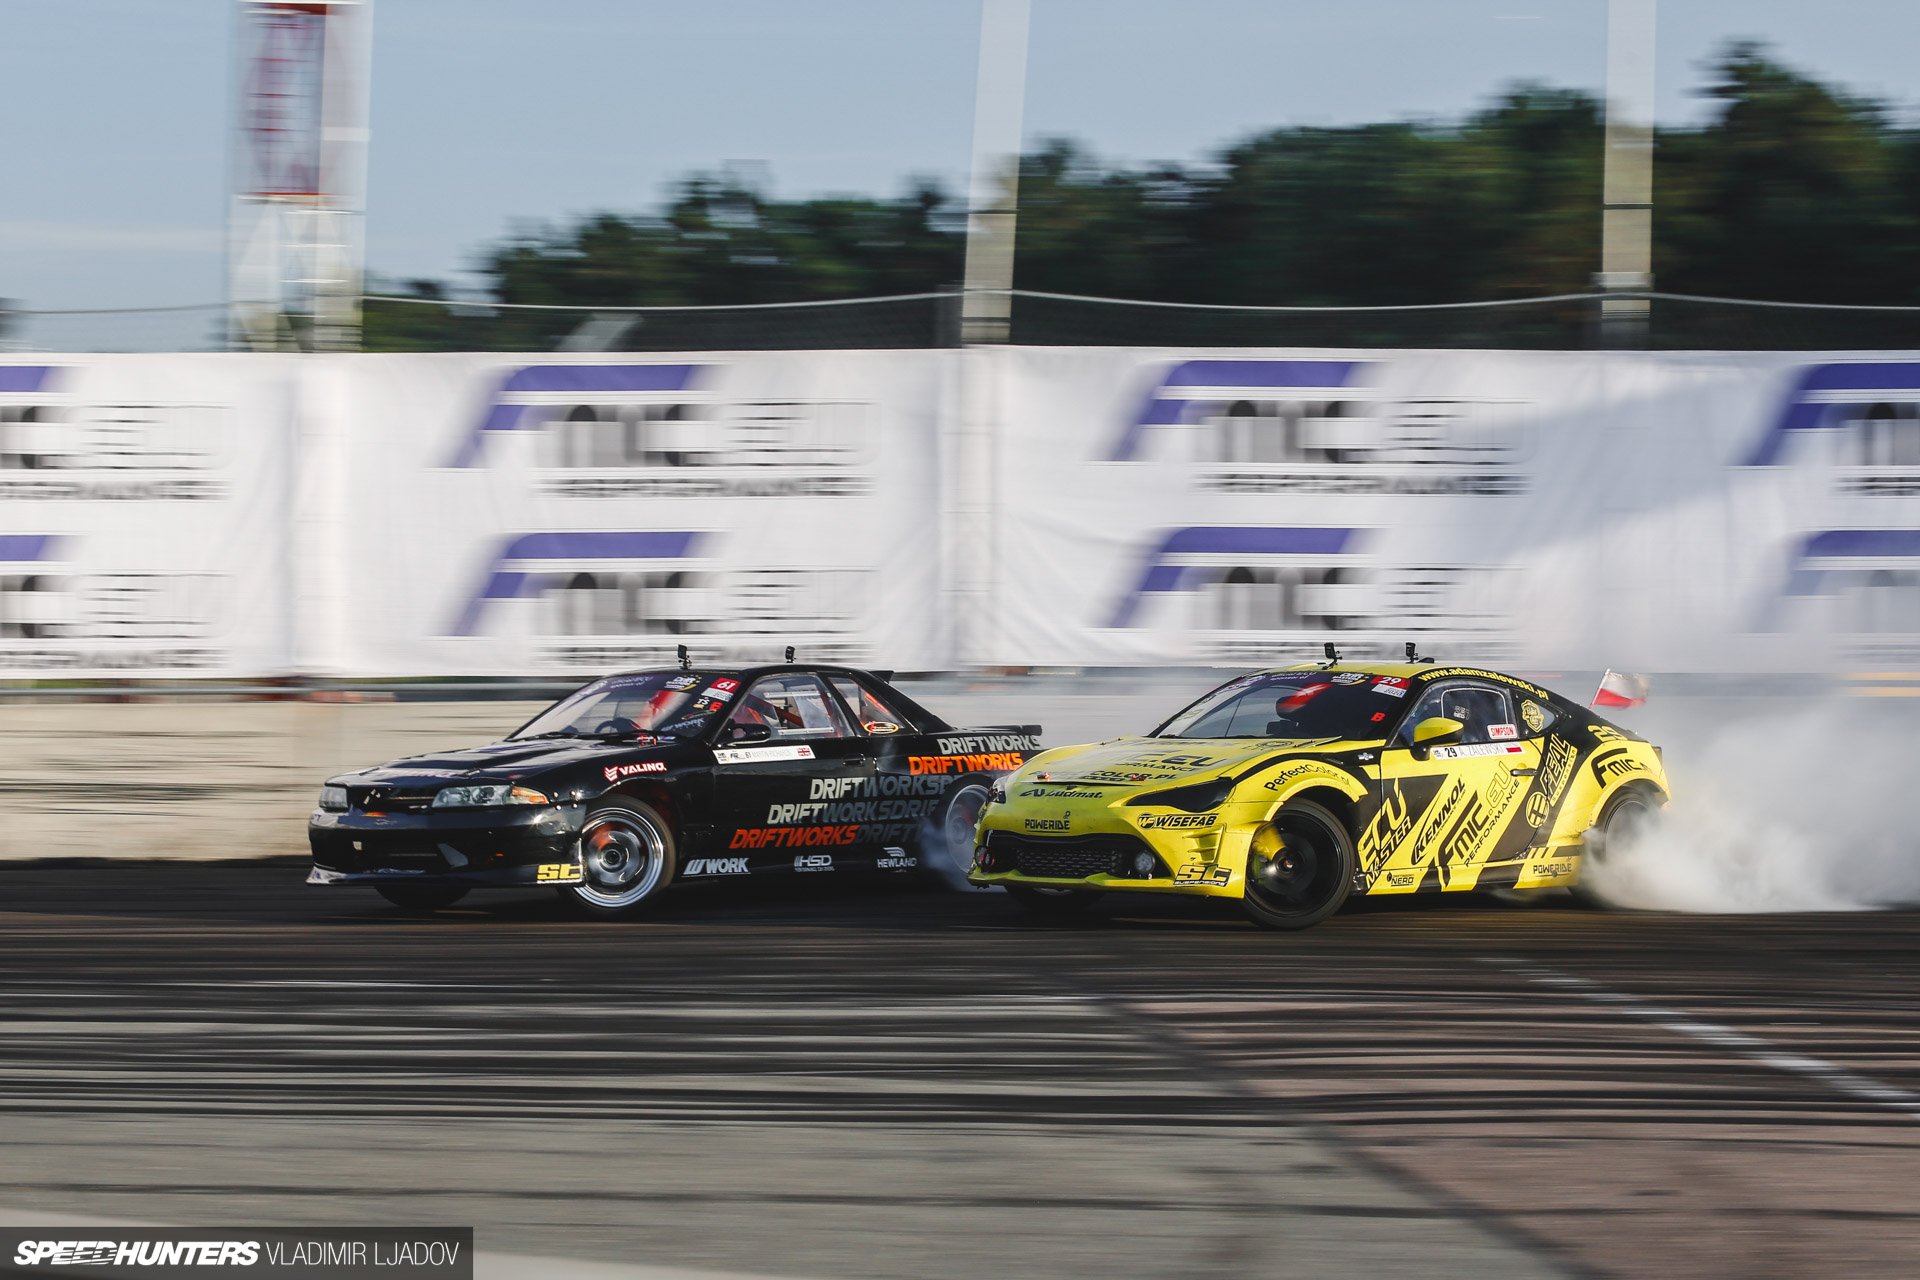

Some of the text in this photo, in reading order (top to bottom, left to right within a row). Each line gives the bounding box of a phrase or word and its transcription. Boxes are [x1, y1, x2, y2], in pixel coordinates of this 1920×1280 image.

[716, 681, 737, 690] 61
[1379, 676, 1402, 685] 29
[1418, 667, 1550, 701] www.adamzalewski.pl
[710, 701, 723, 711] B
[1371, 712, 1386, 722] B
[1490, 726, 1514, 737] SIMPSON
[1587, 725, 1629, 743] 29
[937, 735, 1043, 755] DRIFTWORKS
[1446, 747, 1458, 758] 29
[908, 752, 1024, 775] DRIFTWORKS
[1024, 818, 1071, 831] POWERIDE
[1155, 814, 1218, 828] WISEFAB
[1413, 777, 1465, 863] KENNOL
[1463, 778, 1520, 868] PERFORMANCE
[729, 825, 861, 849] DRIFTWORKS
[1365, 815, 1413, 890] MASTER
[706, 857, 750, 874] WORK
[877, 858, 917, 868] HEWLAND
[1533, 863, 1573, 875] POWERIDE
